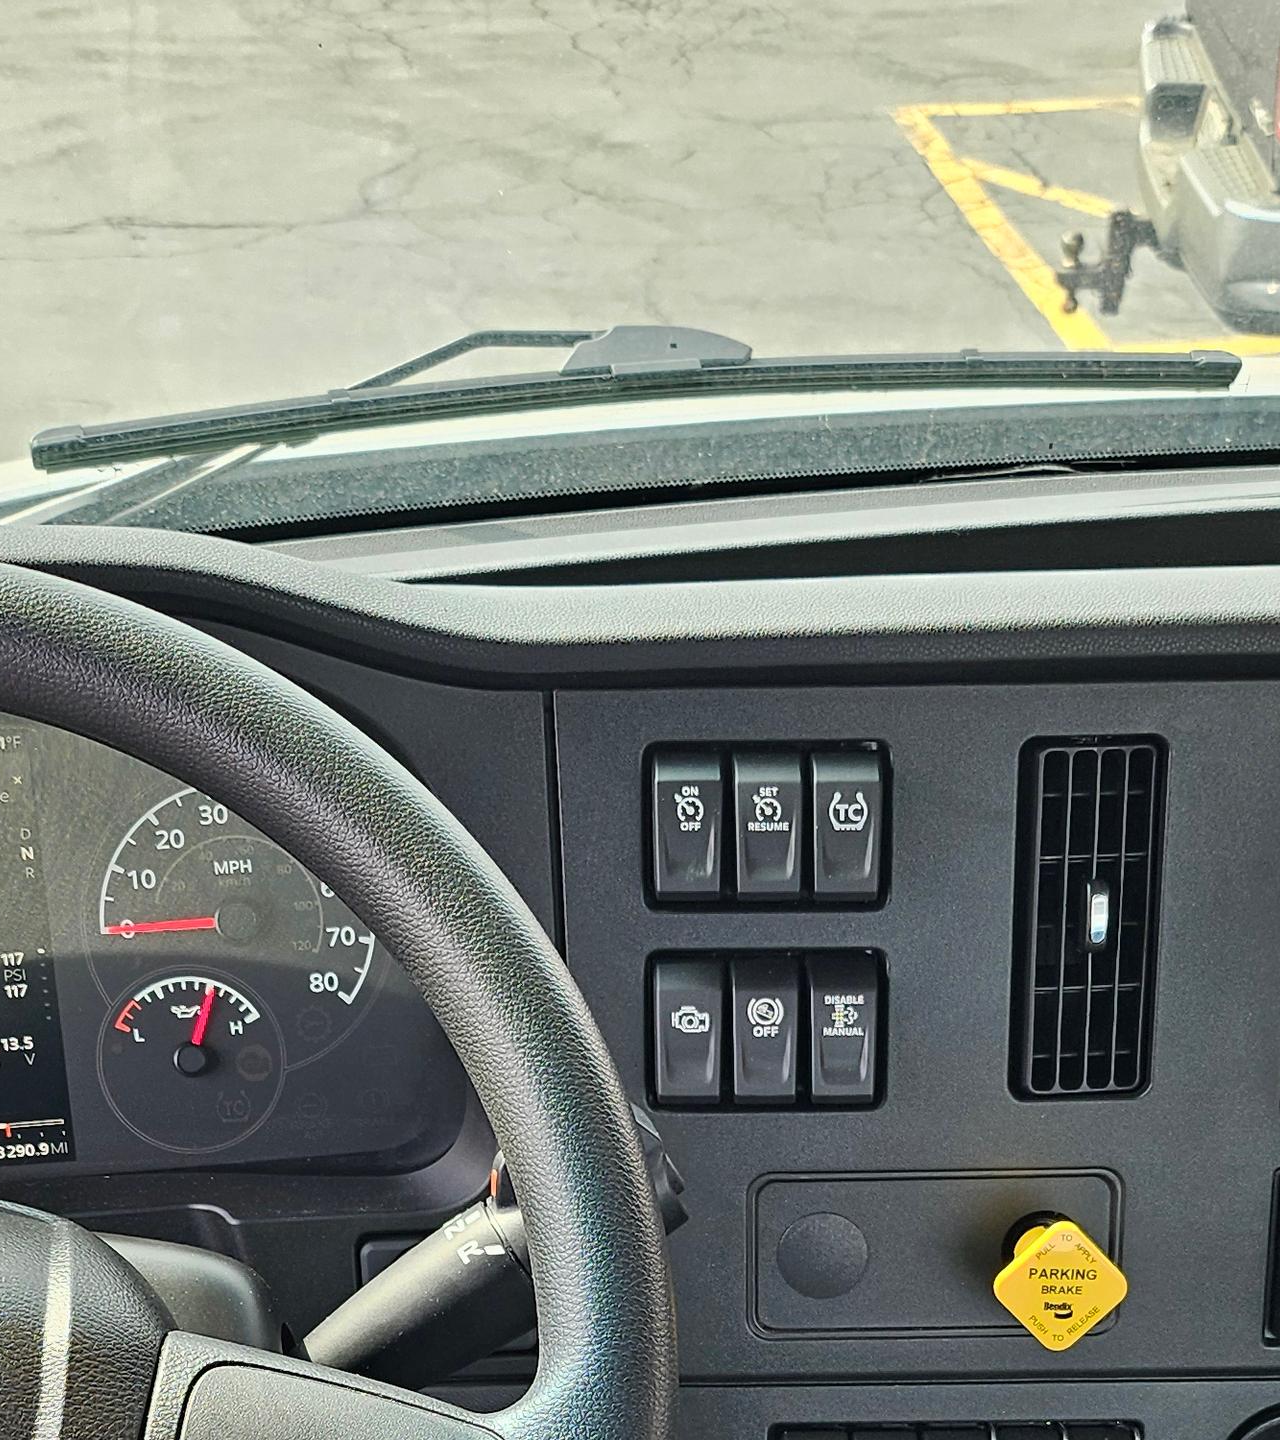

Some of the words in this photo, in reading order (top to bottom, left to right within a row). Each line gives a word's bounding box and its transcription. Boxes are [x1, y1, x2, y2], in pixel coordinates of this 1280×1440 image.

[681, 786, 699, 797] ON
[759, 786, 779, 797] SET
[199, 805, 228, 825] 30
[835, 804, 862, 822] TC
[680, 822, 701, 832] OFF
[748, 821, 790, 832] RESUME
[21, 828, 31, 840] D
[155, 829, 185, 850] 20
[21, 847, 35, 861] N
[25, 867, 36, 879] R
[214, 859, 253, 875] MPH
[127, 869, 157, 890] 10
[120, 919, 136, 939] 0
[326, 926, 356, 947] 70
[0, 952, 25, 966] 117
[4, 970, 27, 983] PSI
[309, 972, 339, 993] 80
[4, 984, 28, 999] 117
[824, 995, 865, 1005] DISABLE
[132, 1028, 145, 1042] L
[229, 1021, 243, 1035] H
[752, 1026, 779, 1037] OFF
[823, 1027, 864, 1037] MANUAL
[0, 1036, 34, 1051] 13.5
[24, 1052, 36, 1066] V
[50, 1142, 69, 1155] MI
[444, 1219, 466, 1241] N
[456, 1240, 485, 1265] R
[1035, 1243, 1056, 1260] PULL
[1061, 1234, 1073, 1242] TO
[1074, 1242, 1097, 1264] APPLY
[1028, 1267, 1098, 1281] PARKING
[1041, 1285, 1083, 1295] BRAKE
[1043, 1301, 1073, 1311] Bendix
[1029, 1315, 1048, 1335] PUSH
[1052, 1334, 1064, 1342] TO
[1066, 1305, 1101, 1336] RELEASE
